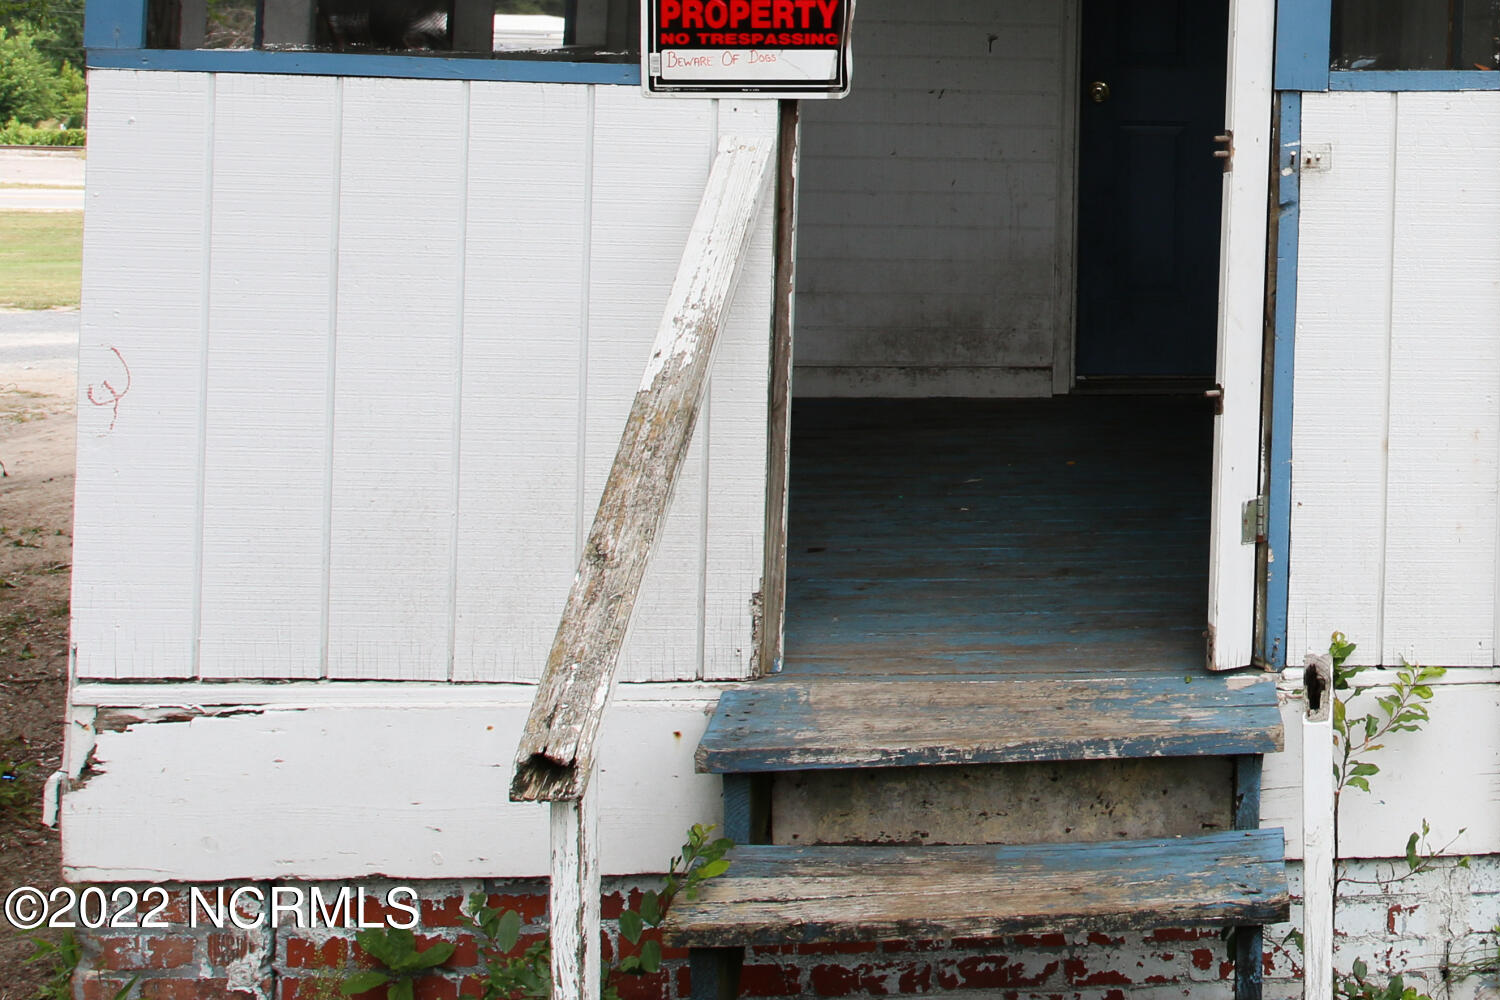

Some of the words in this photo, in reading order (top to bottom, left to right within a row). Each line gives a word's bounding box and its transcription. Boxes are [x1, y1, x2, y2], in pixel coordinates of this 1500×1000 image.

[660, 0, 839, 29] PROPERTY
[660, 32, 690, 45] NO
[697, 32, 839, 46] TRESPASSING
[666, 50, 714, 68] BEWARE
[721, 50, 740, 67] OF
[748, 49, 777, 65] DOGS
